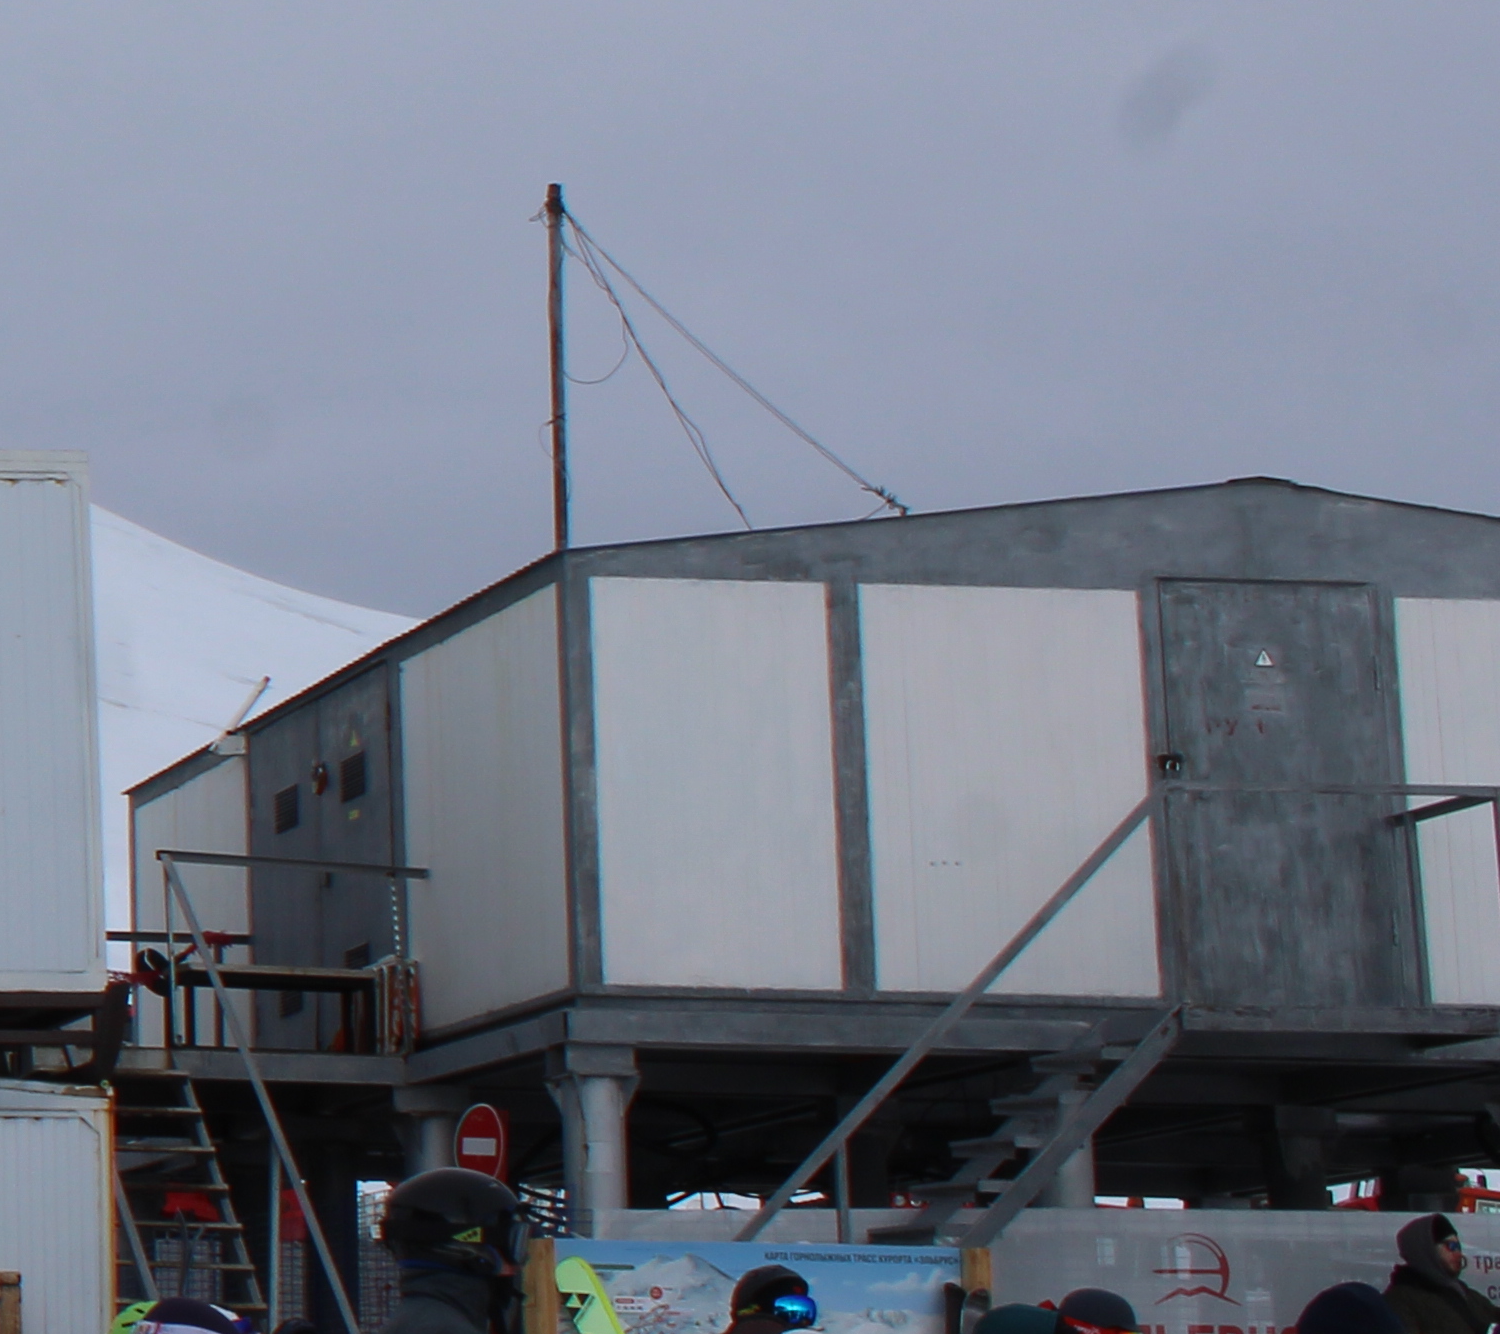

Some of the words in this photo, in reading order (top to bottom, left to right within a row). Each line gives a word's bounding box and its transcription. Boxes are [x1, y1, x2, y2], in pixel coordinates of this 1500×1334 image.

[764, 1251, 789, 1262] КАРТА
[790, 1252, 851, 1263] ГОРНОЛЫЖНЫХ
[852, 1253, 877, 1264] ТРАСС
[878, 1254, 912, 1265] КУРОРТА
